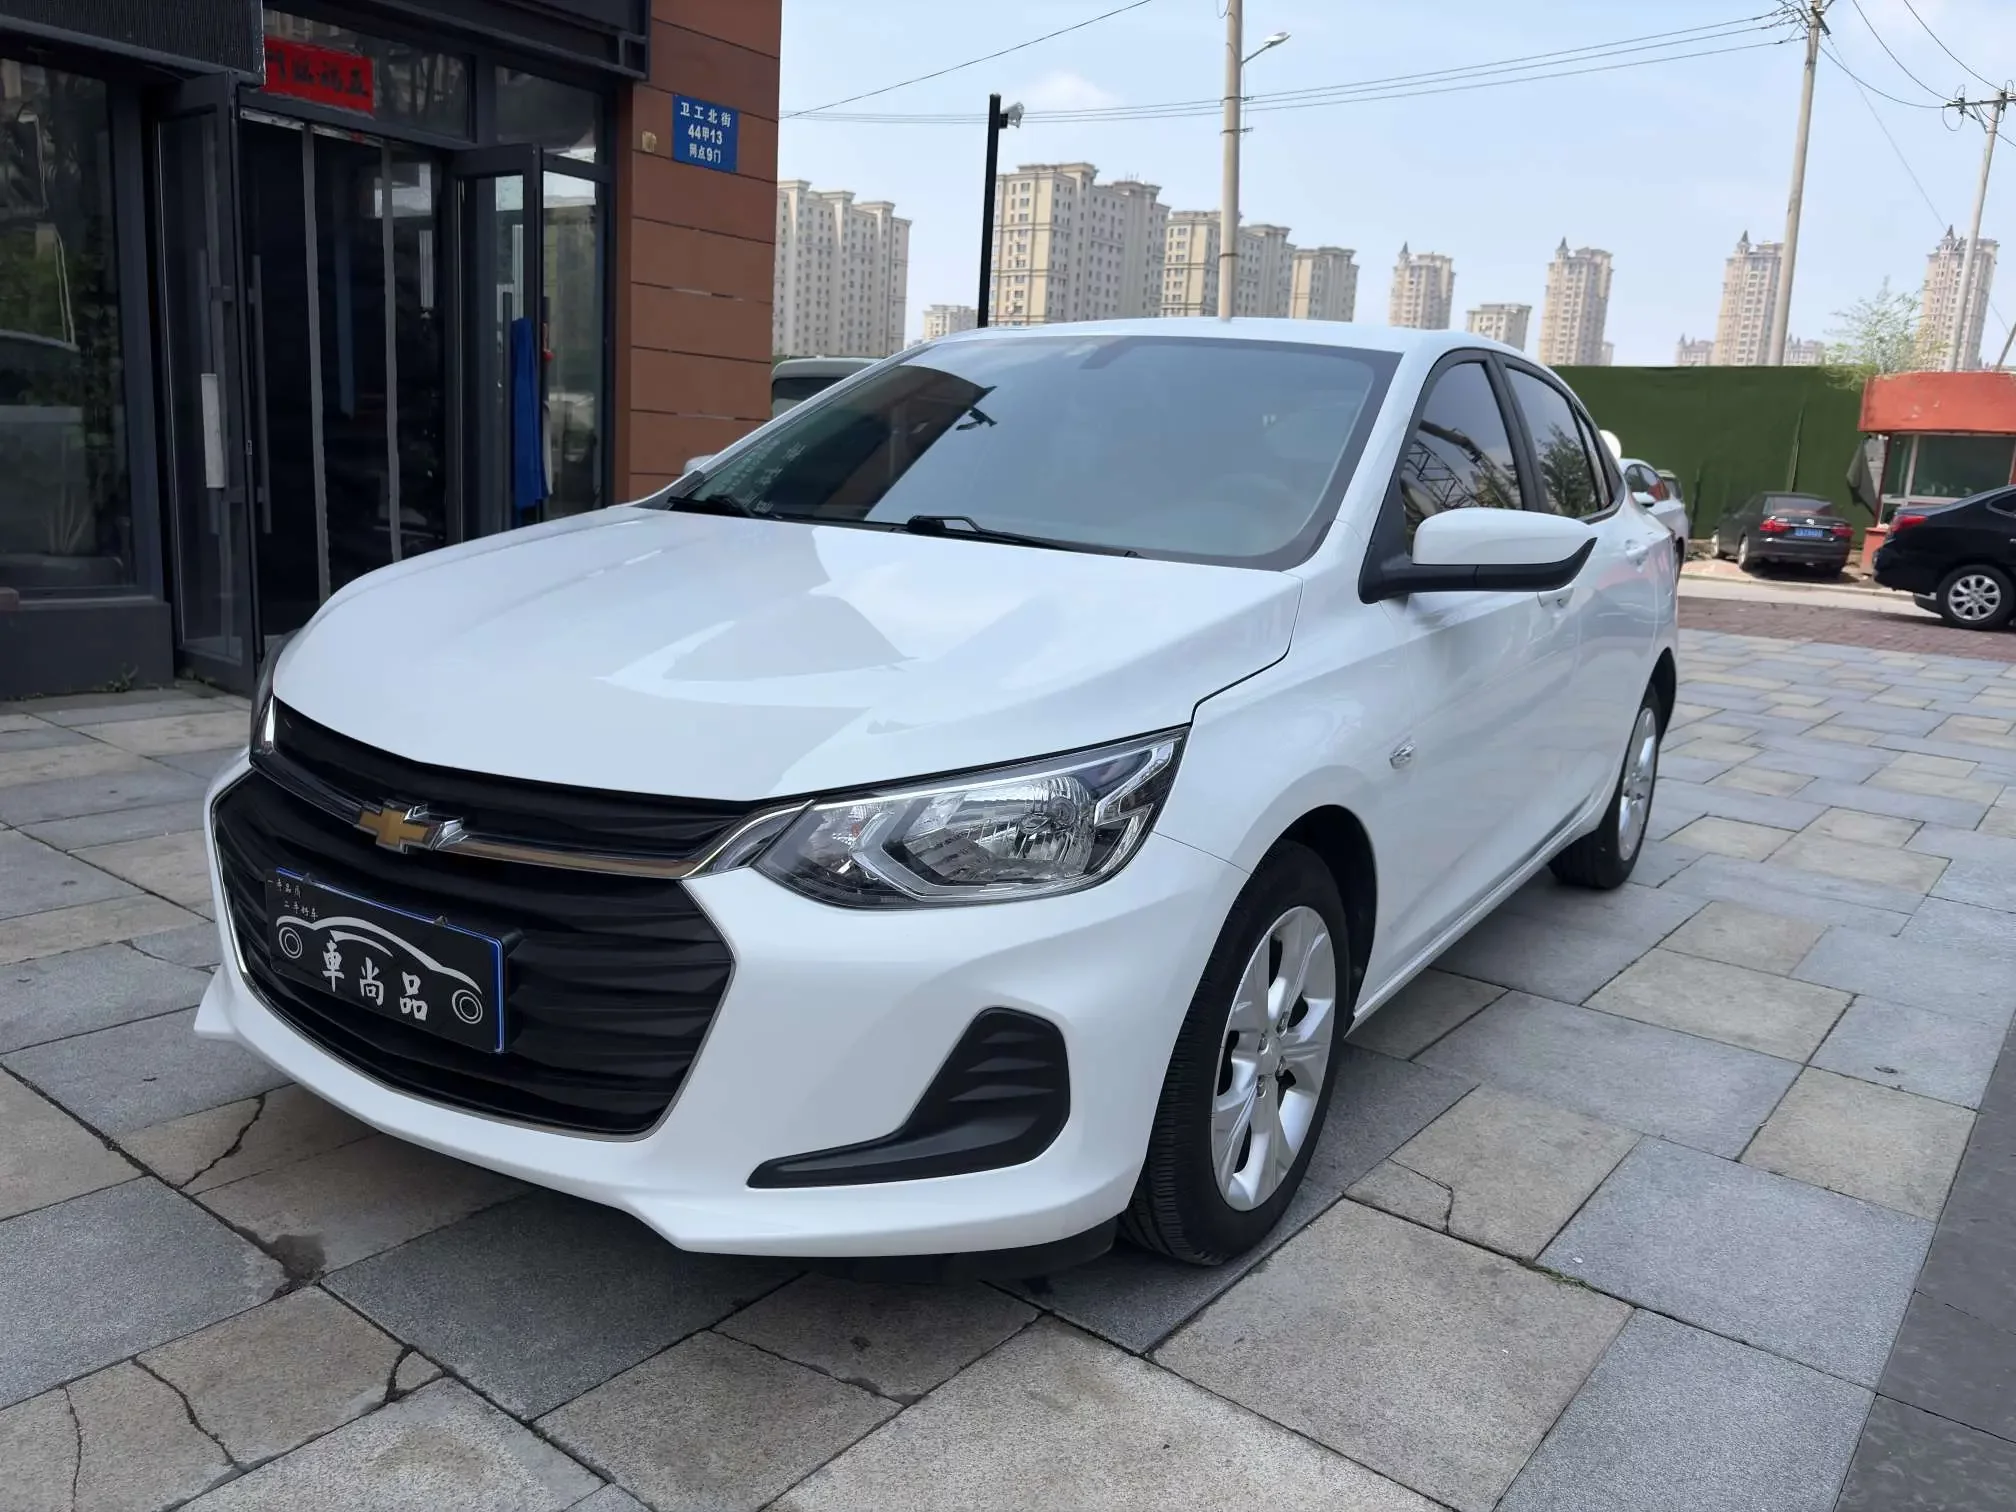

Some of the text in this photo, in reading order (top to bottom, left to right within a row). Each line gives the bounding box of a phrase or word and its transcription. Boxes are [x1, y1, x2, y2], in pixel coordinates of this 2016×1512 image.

[680, 102, 731, 128] 卫工北街
[687, 124, 723, 145] 44甲13
